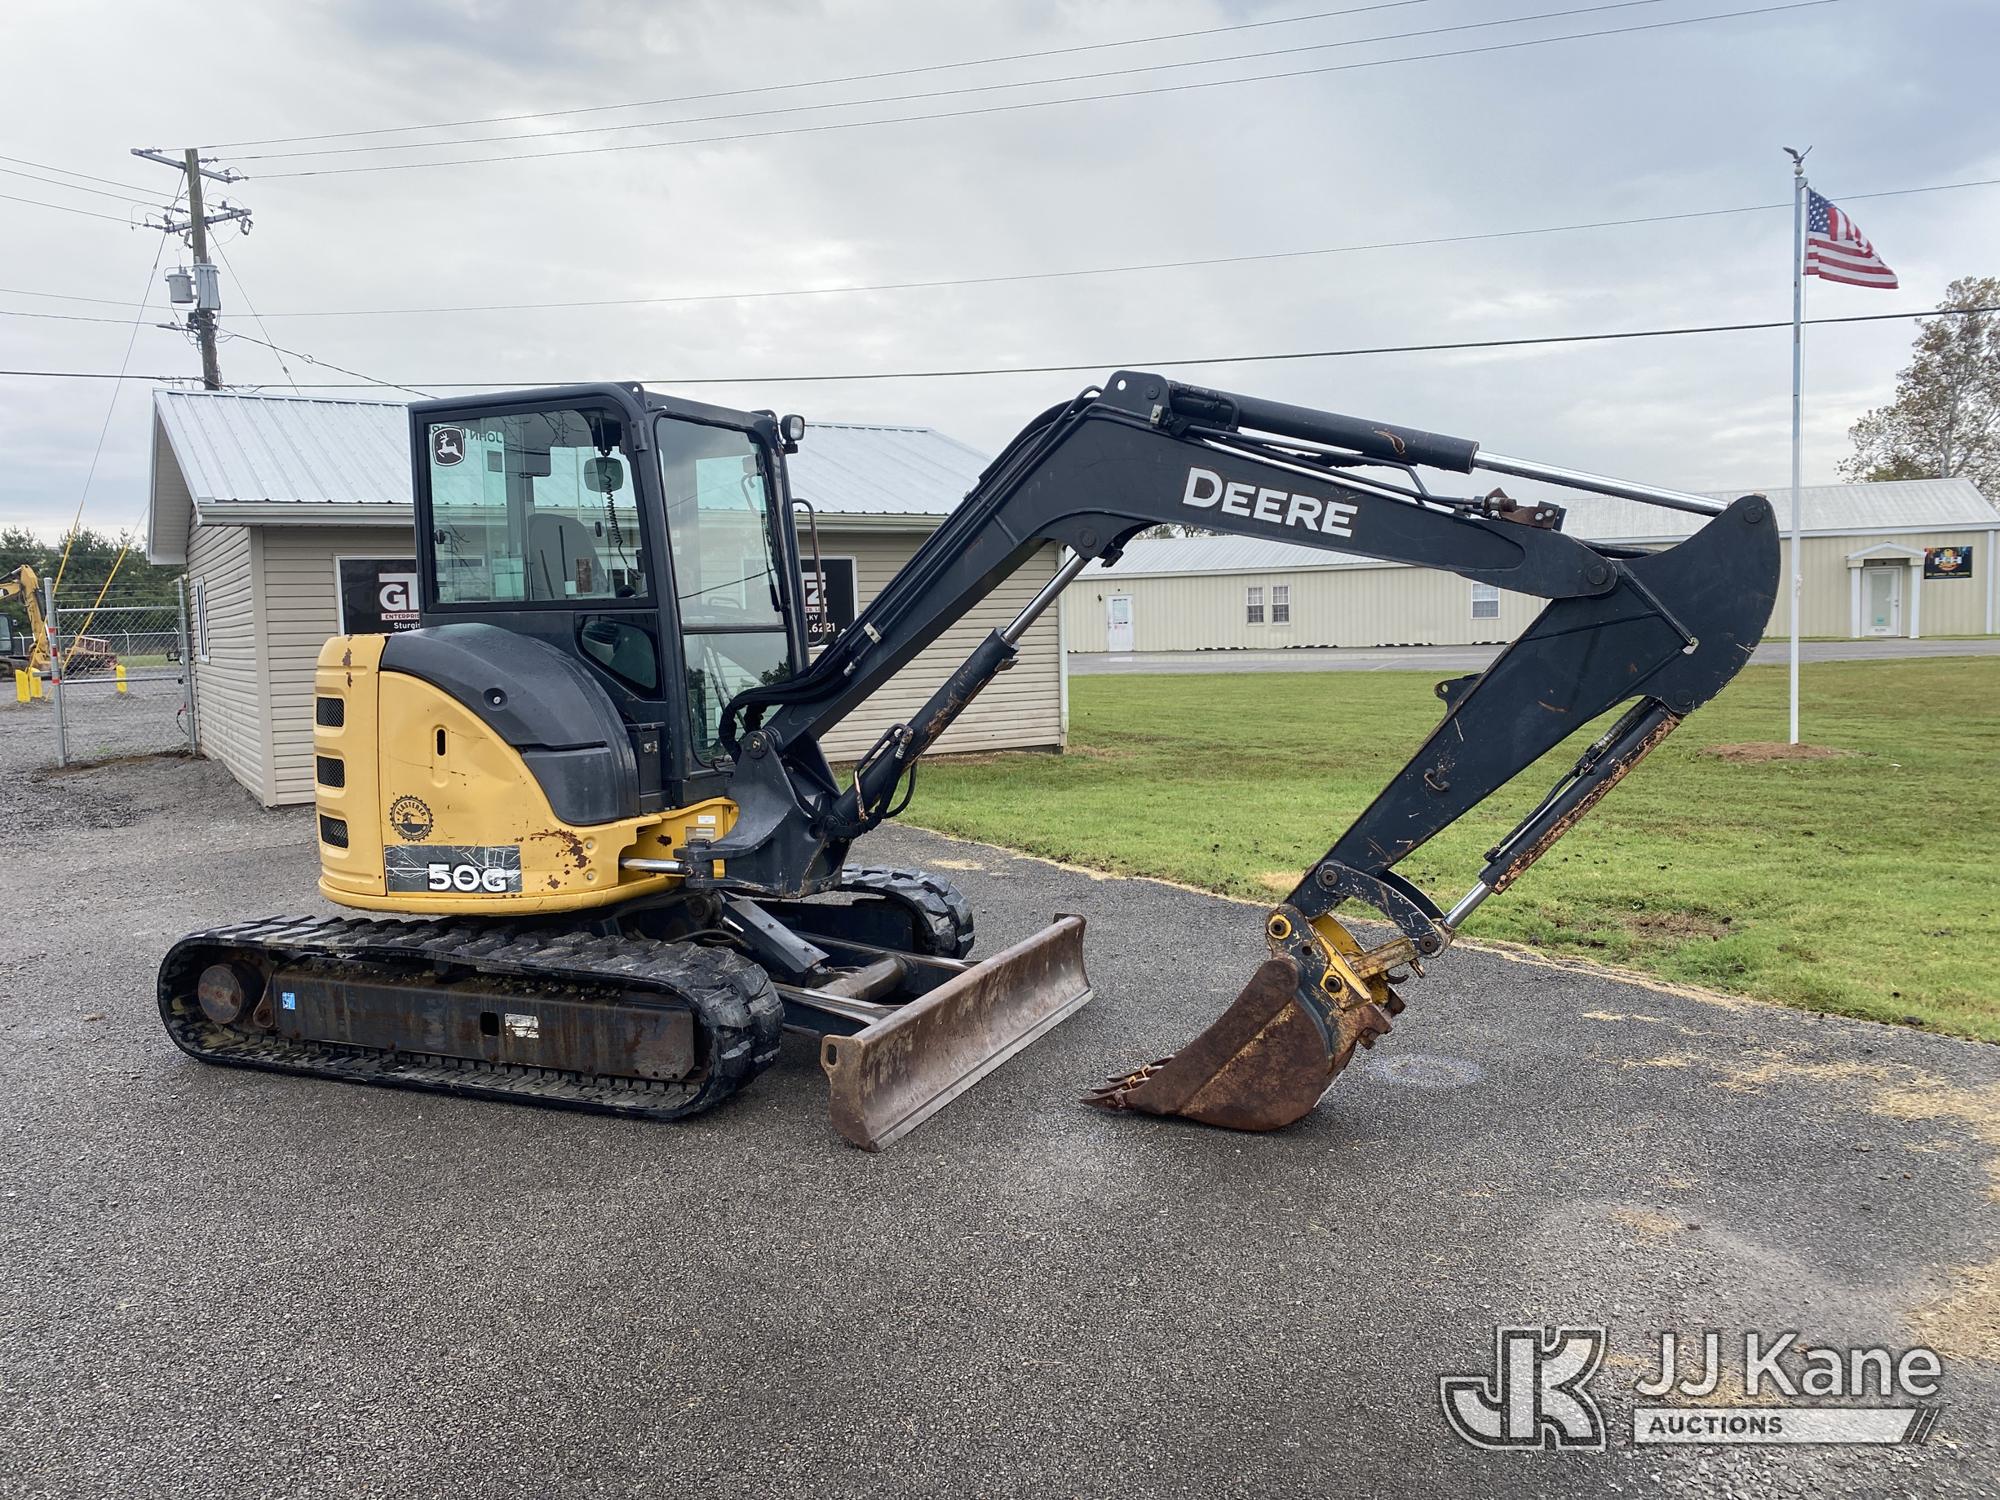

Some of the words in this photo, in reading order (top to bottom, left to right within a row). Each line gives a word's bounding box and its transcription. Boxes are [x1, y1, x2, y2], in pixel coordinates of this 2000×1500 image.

[1183, 467, 1358, 537] DEERE
[379, 572, 419, 611] GT
[394, 621, 420, 630] Sturgi
[809, 622, 836, 633] .6221
[428, 864, 506, 891] 50G
